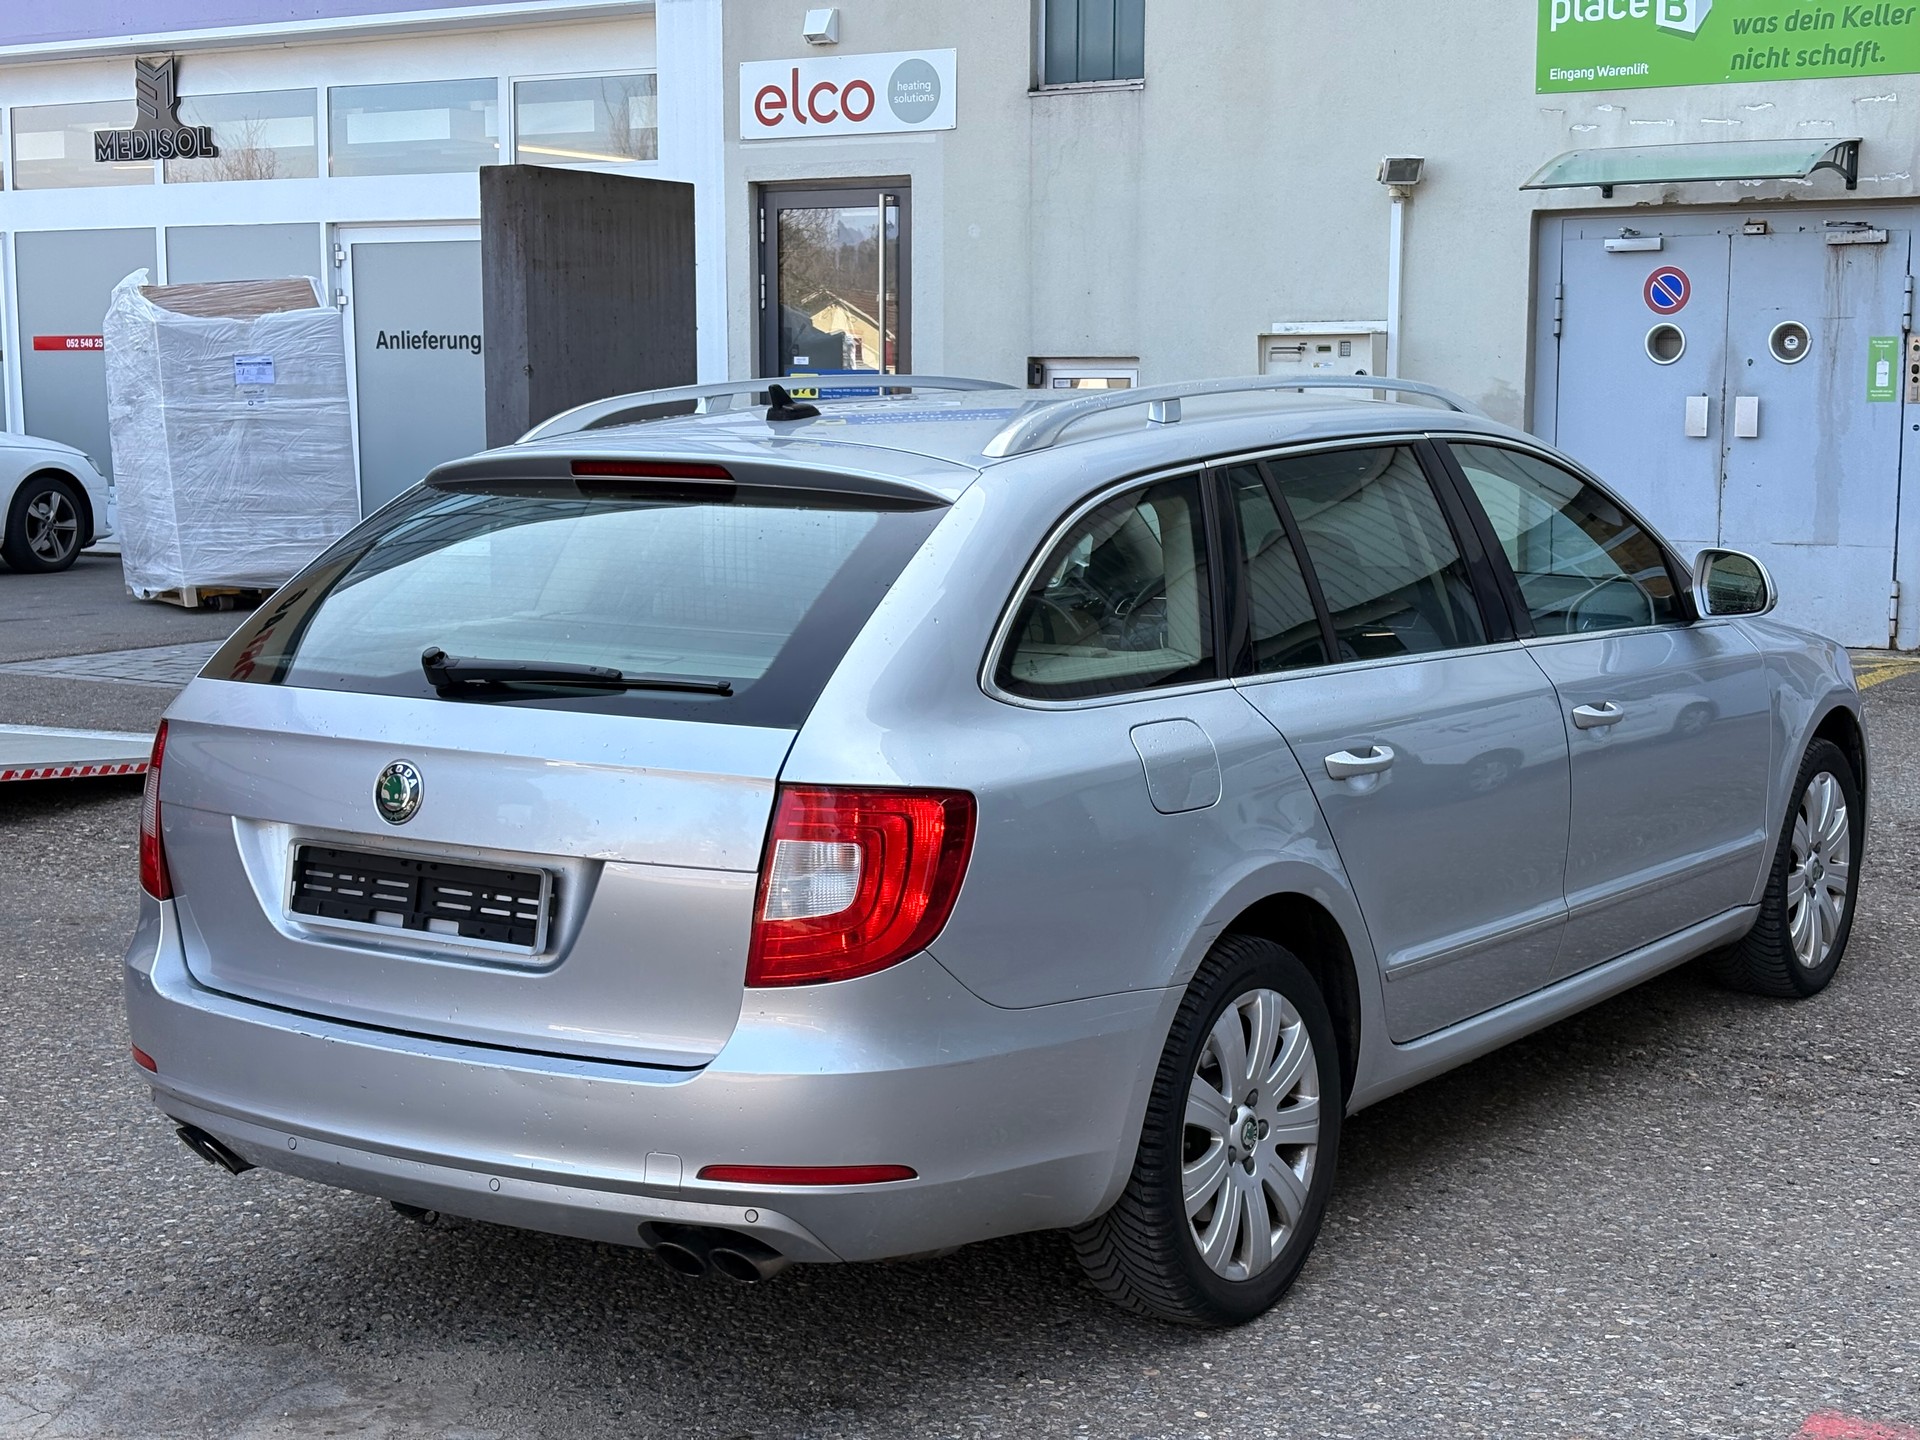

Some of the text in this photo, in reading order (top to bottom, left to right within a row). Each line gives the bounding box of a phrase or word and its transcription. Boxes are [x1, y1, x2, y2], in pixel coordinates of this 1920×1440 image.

[1733, 3, 1916, 35] was dein Keller
[1730, 40, 1886, 70] nicht schafft.
[1549, 62, 1649, 81] Eingang Warenlift
[755, 68, 875, 126] elco
[893, 92, 935, 104] solutions
[896, 80, 932, 93] heating
[94, 126, 218, 162] MEDISOL
[66, 338, 79, 348] 052
[80, 338, 93, 348] 548
[375, 330, 482, 355] Anlieferung
